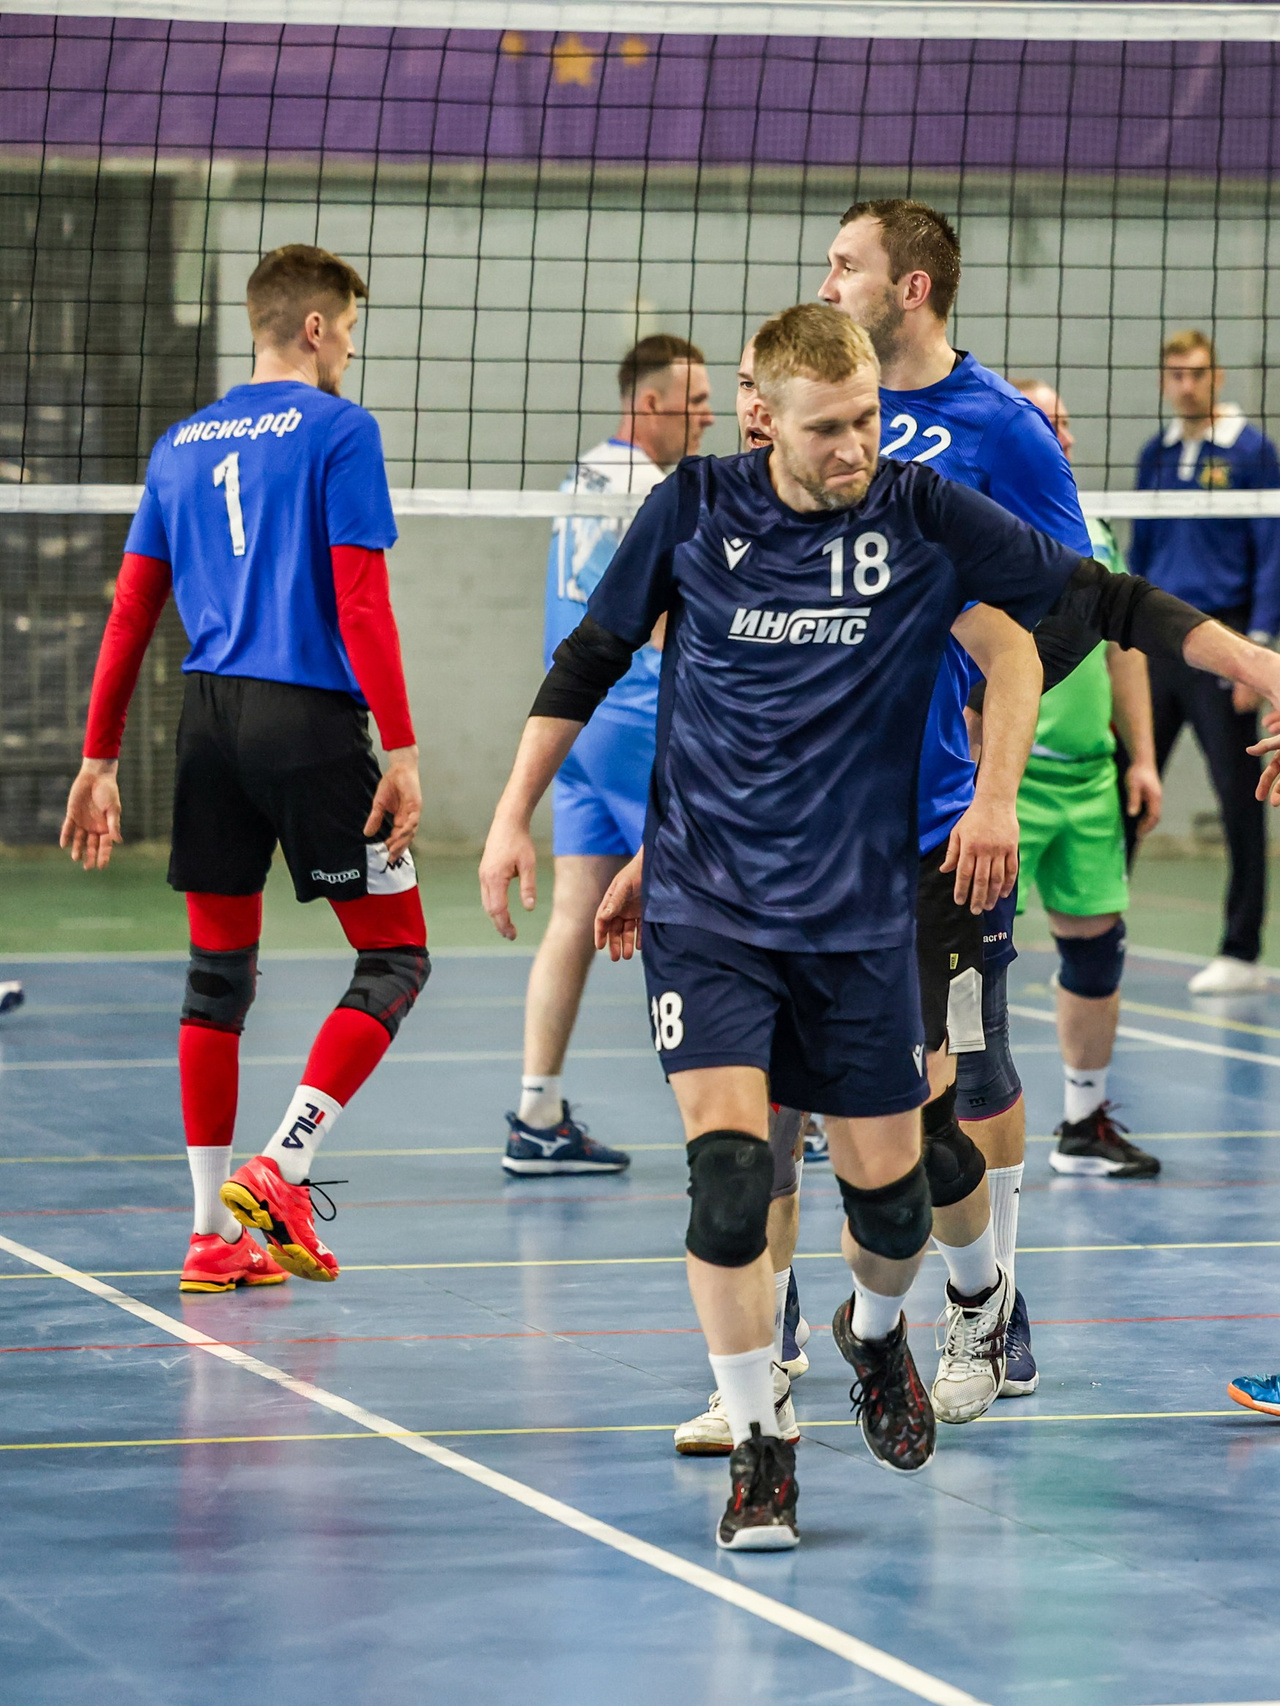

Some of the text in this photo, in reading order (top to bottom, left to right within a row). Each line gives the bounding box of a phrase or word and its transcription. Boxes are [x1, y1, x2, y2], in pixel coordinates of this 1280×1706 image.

[880, 413, 951, 463] 22
[213, 451, 246, 557] 1
[822, 531, 892, 597] 18
[728, 607, 871, 645] ИНСИС
[311, 869, 360, 884] Kappa
[651, 991, 684, 1052] 18
[282, 1102, 326, 1149] FILA
